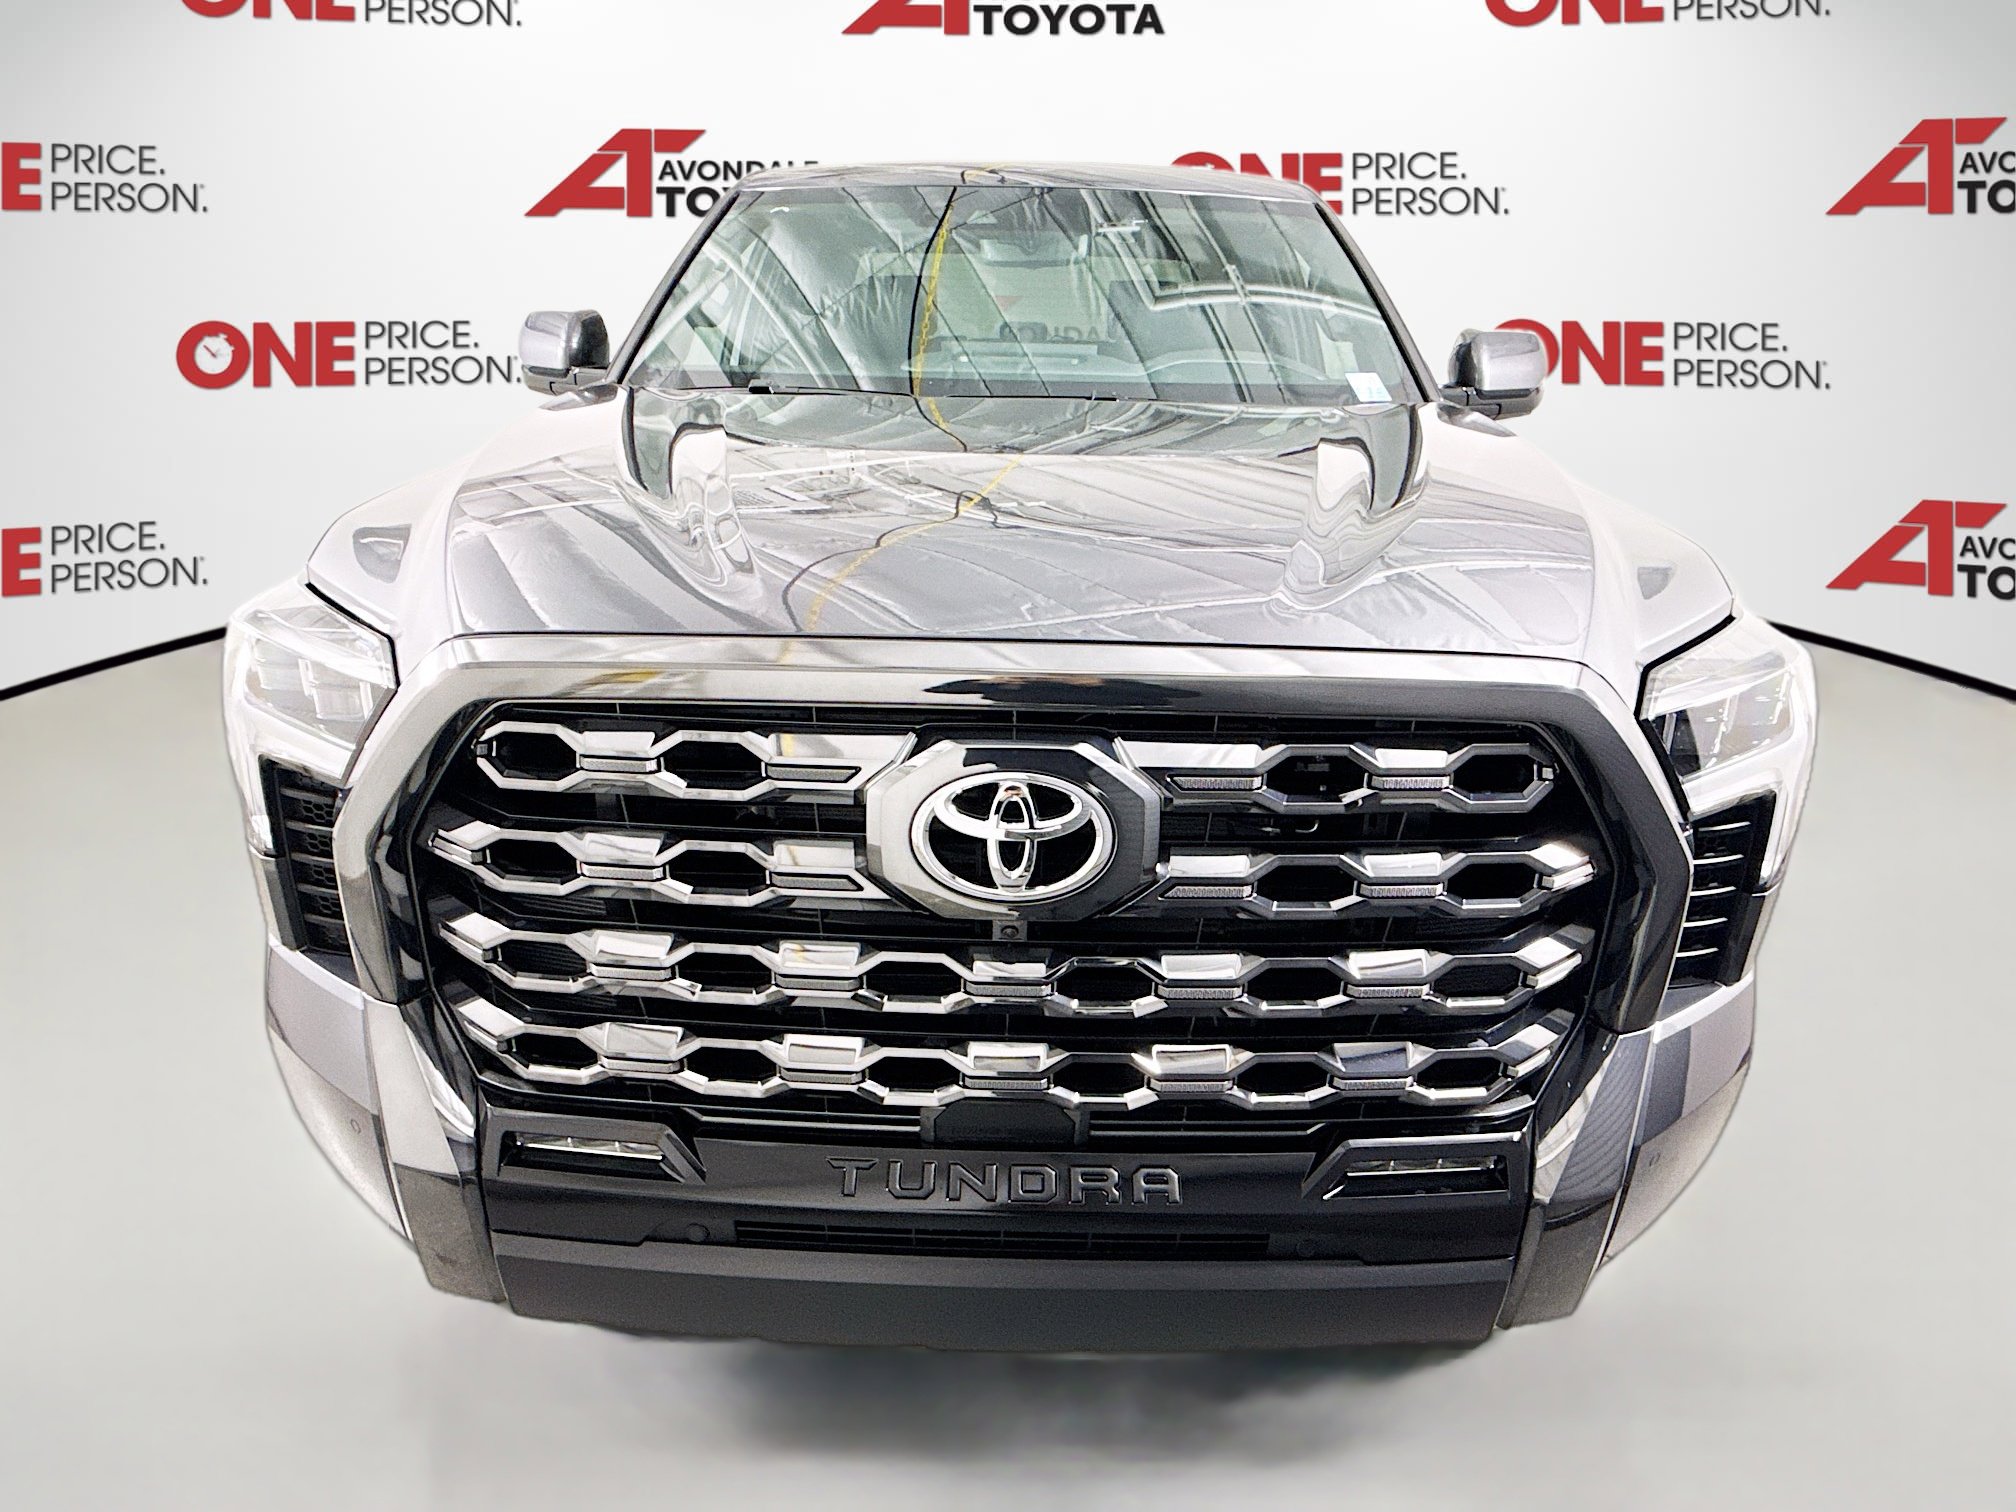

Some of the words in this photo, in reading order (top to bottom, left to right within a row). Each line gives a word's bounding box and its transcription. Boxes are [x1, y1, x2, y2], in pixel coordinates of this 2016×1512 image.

[366, 0, 521, 26] PERSON.
[973, 4, 1164, 35] TOYOTA
[51, 143, 165, 175] PRICE.
[1352, 152, 1467, 180] PRICE.
[51, 182, 208, 213] PERSON.
[1352, 187, 1509, 215] PERSON.
[365, 320, 479, 350] PRICE.
[1673, 322, 1788, 351] PRICE.
[176, 320, 355, 389] ONE
[365, 355, 521, 386] PERSON.
[1673, 359, 1831, 389] PERSON.
[51, 521, 165, 555] PRICE.
[51, 556, 208, 594] PERSON.
[826, 1156, 1183, 1205] TUNDRA
